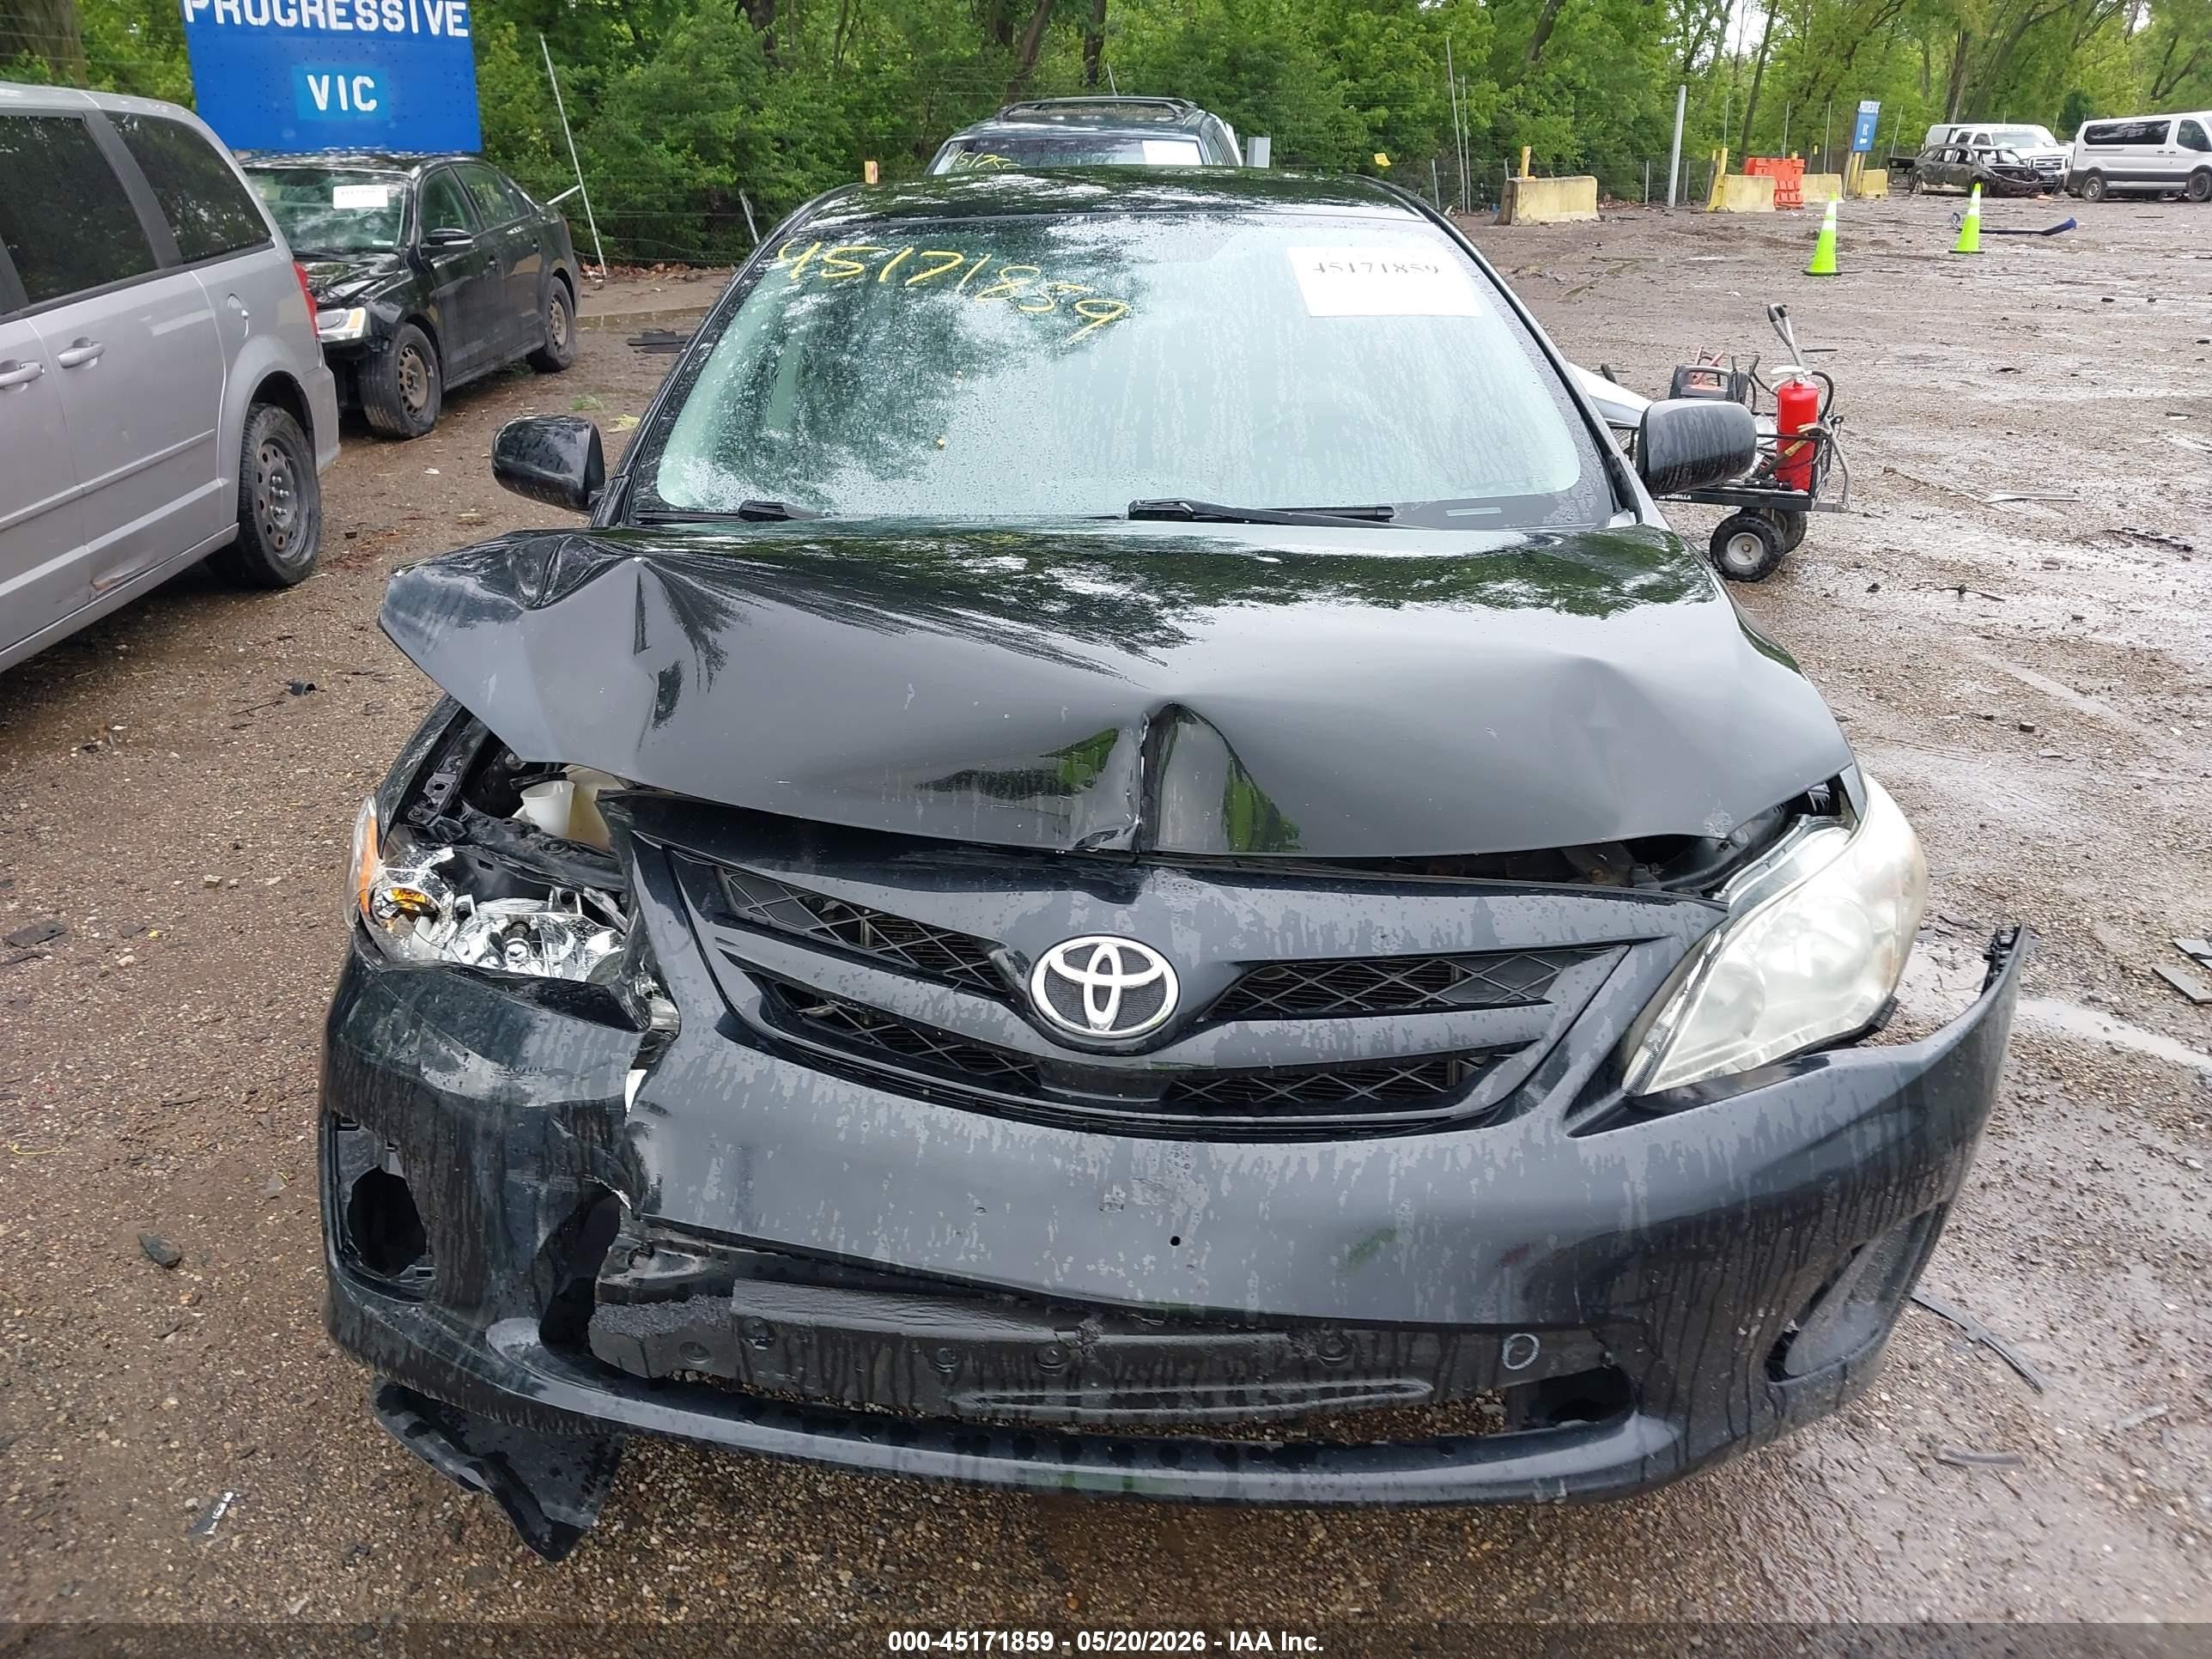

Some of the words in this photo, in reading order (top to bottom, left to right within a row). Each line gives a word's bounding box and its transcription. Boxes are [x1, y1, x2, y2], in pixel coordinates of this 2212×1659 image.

[182, 0, 470, 38] PROGRESSIVE
[307, 75, 378, 112] VIC
[777, 240, 1130, 345] 45171859
